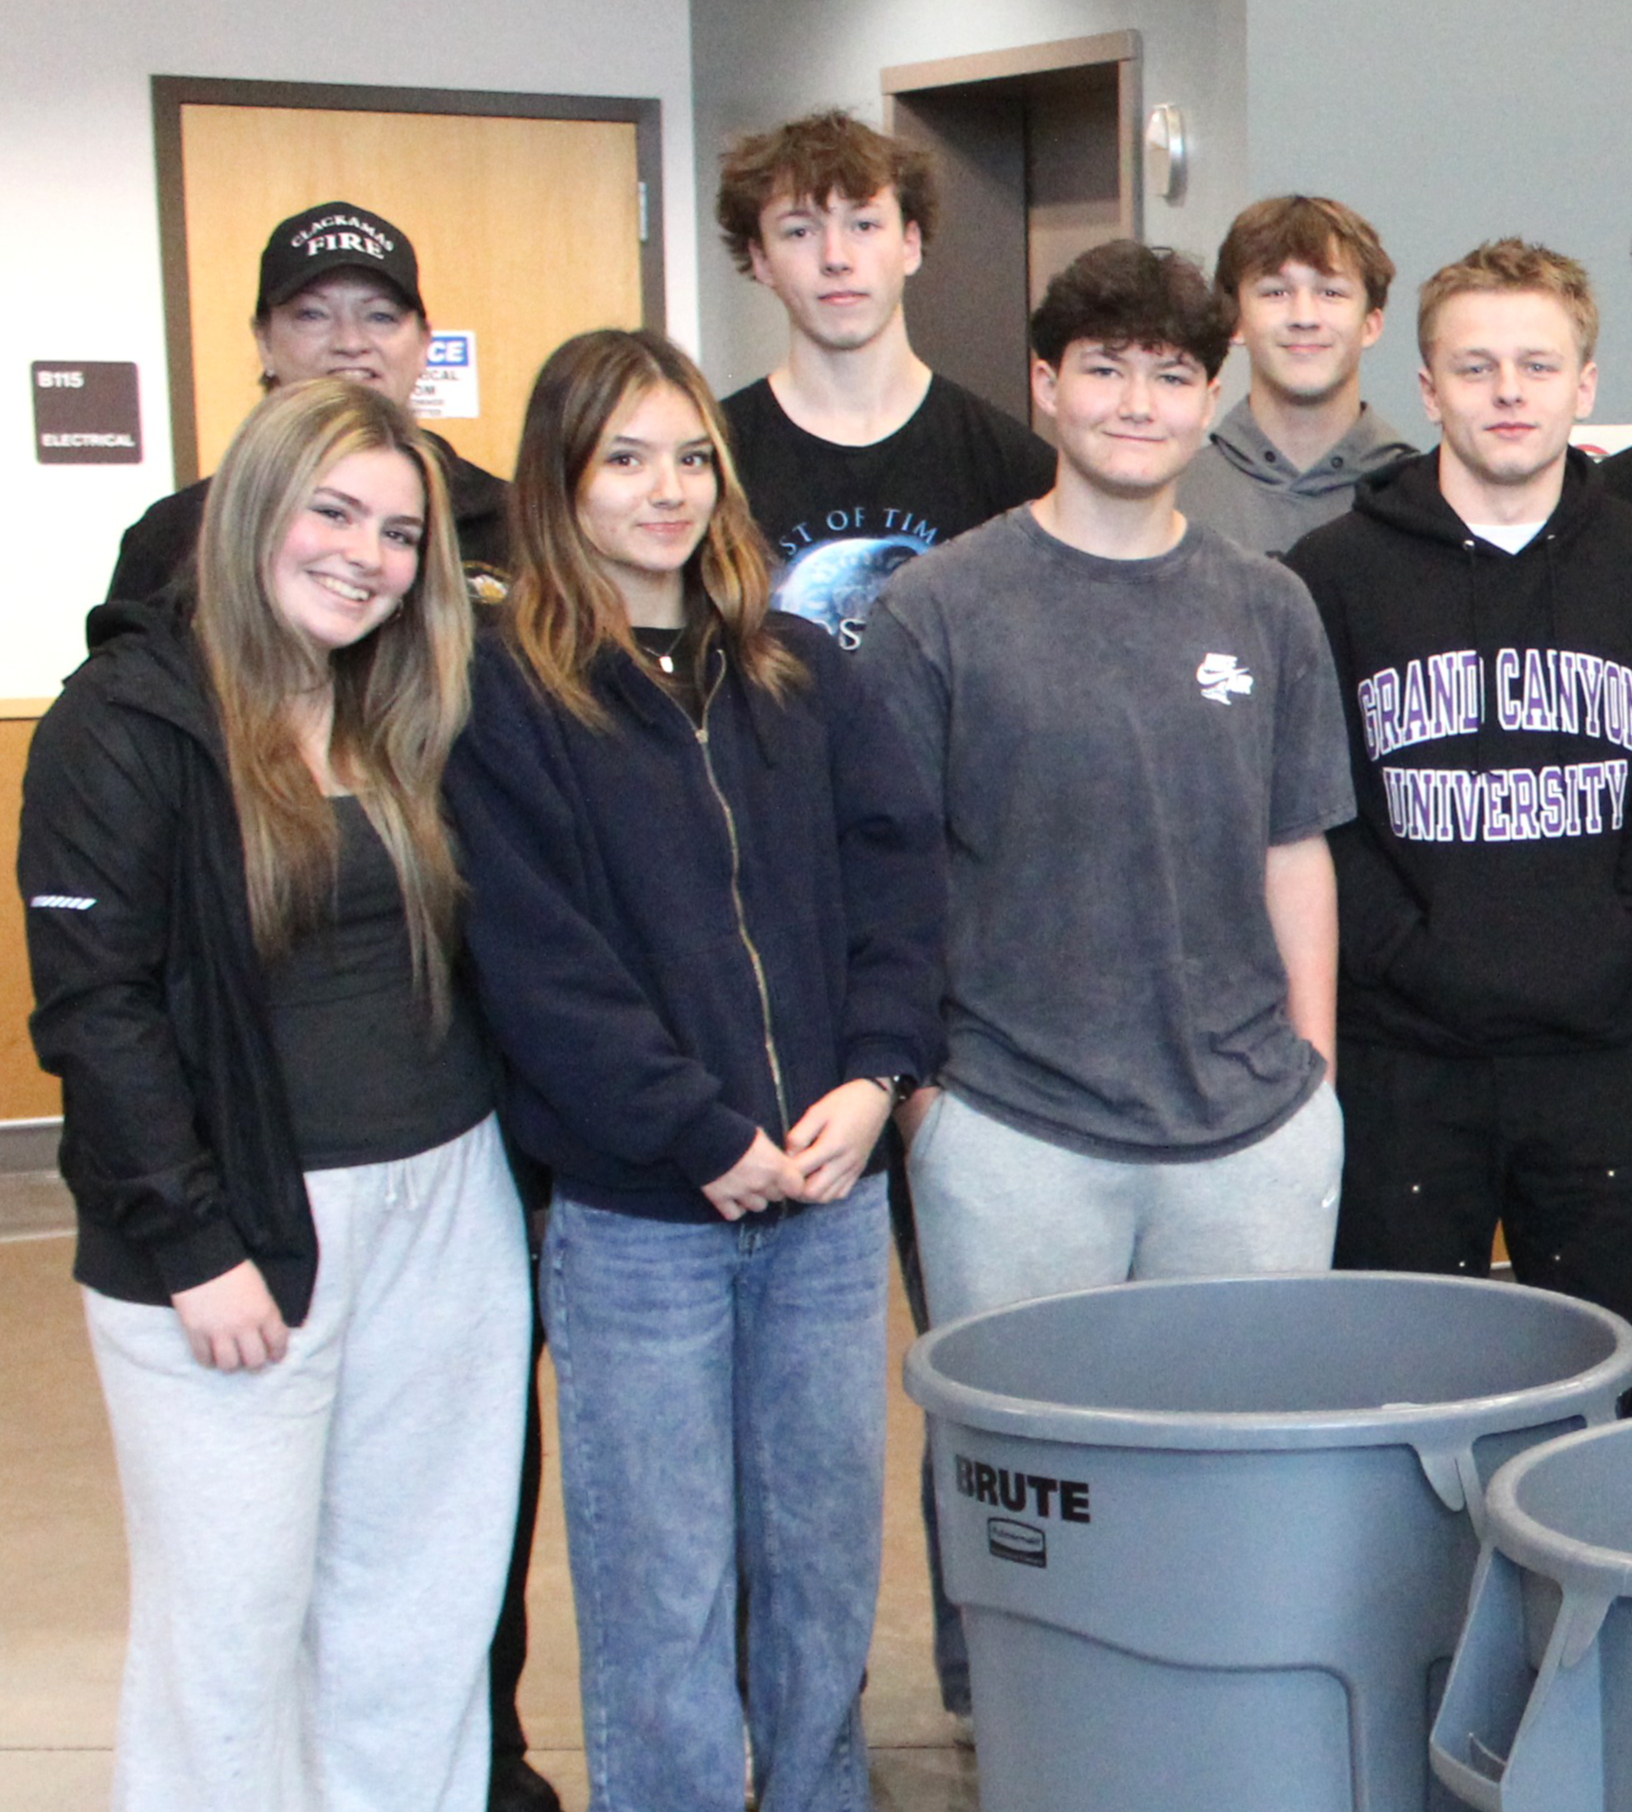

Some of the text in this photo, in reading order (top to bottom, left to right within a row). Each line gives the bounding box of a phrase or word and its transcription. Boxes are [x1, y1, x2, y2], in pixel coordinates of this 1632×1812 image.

[291, 214, 394, 252] CLACKAMAS
[306, 232, 385, 260] FIRE
[37, 370, 85, 389] B115
[41, 433, 136, 448] ELECTRICAL
[826, 506, 866, 531] OF
[883, 508, 938, 544] TIM
[1358, 650, 1485, 761] GRAND
[1383, 759, 1628, 842] UNIVERSITY
[956, 1454, 1091, 1523] BRUTE
